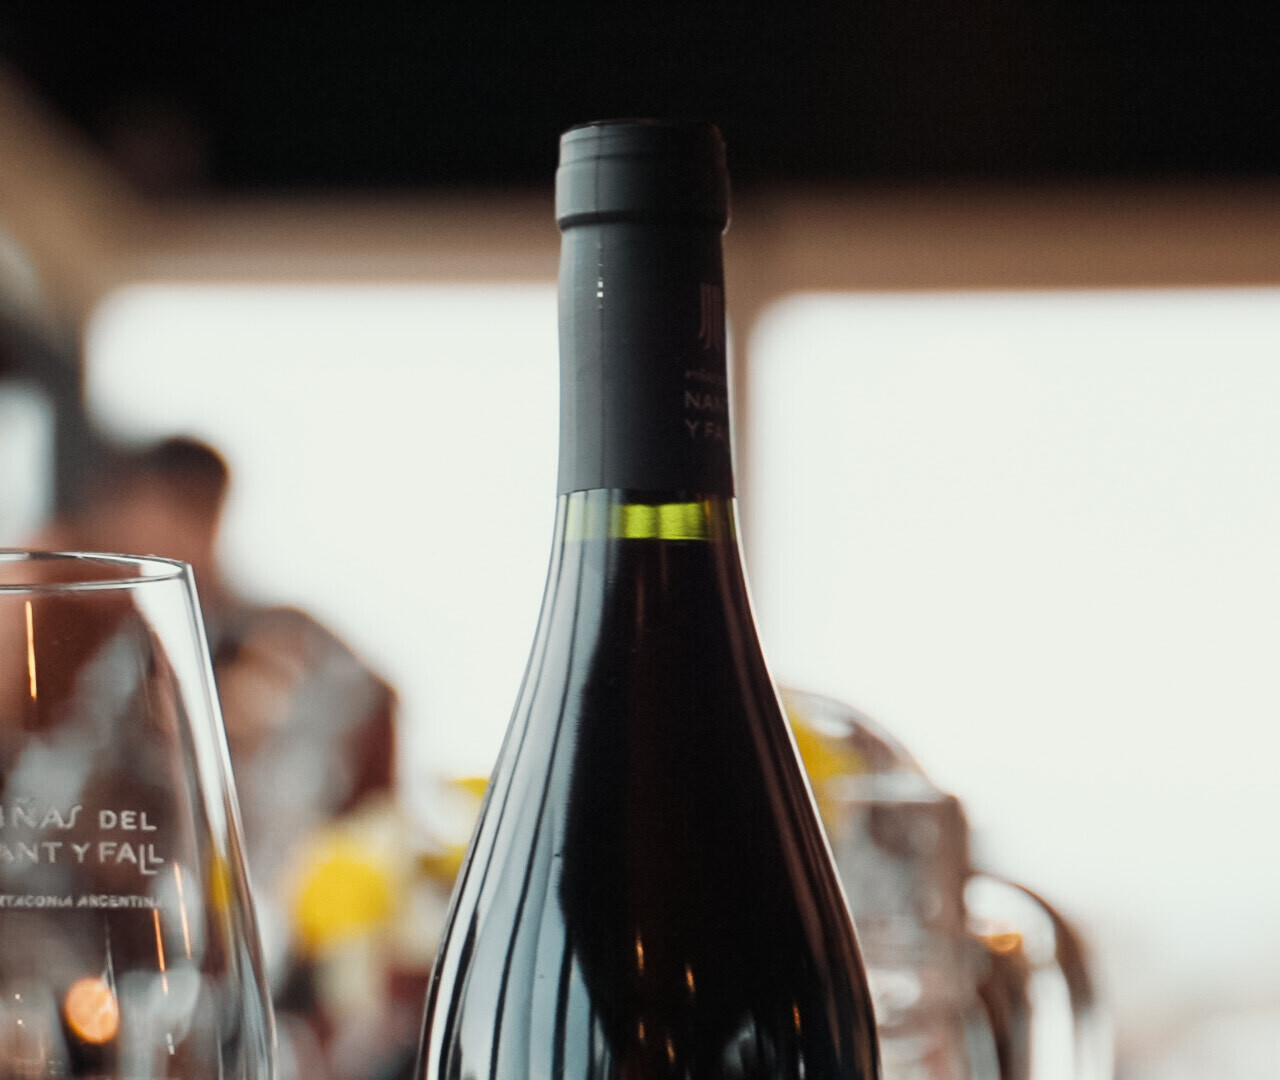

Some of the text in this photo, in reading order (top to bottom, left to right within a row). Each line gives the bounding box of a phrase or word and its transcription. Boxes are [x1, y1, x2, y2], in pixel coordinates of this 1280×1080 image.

[99, 810, 157, 831] DEL
[72, 843, 91, 864] Y
[99, 843, 164, 875] FALL
